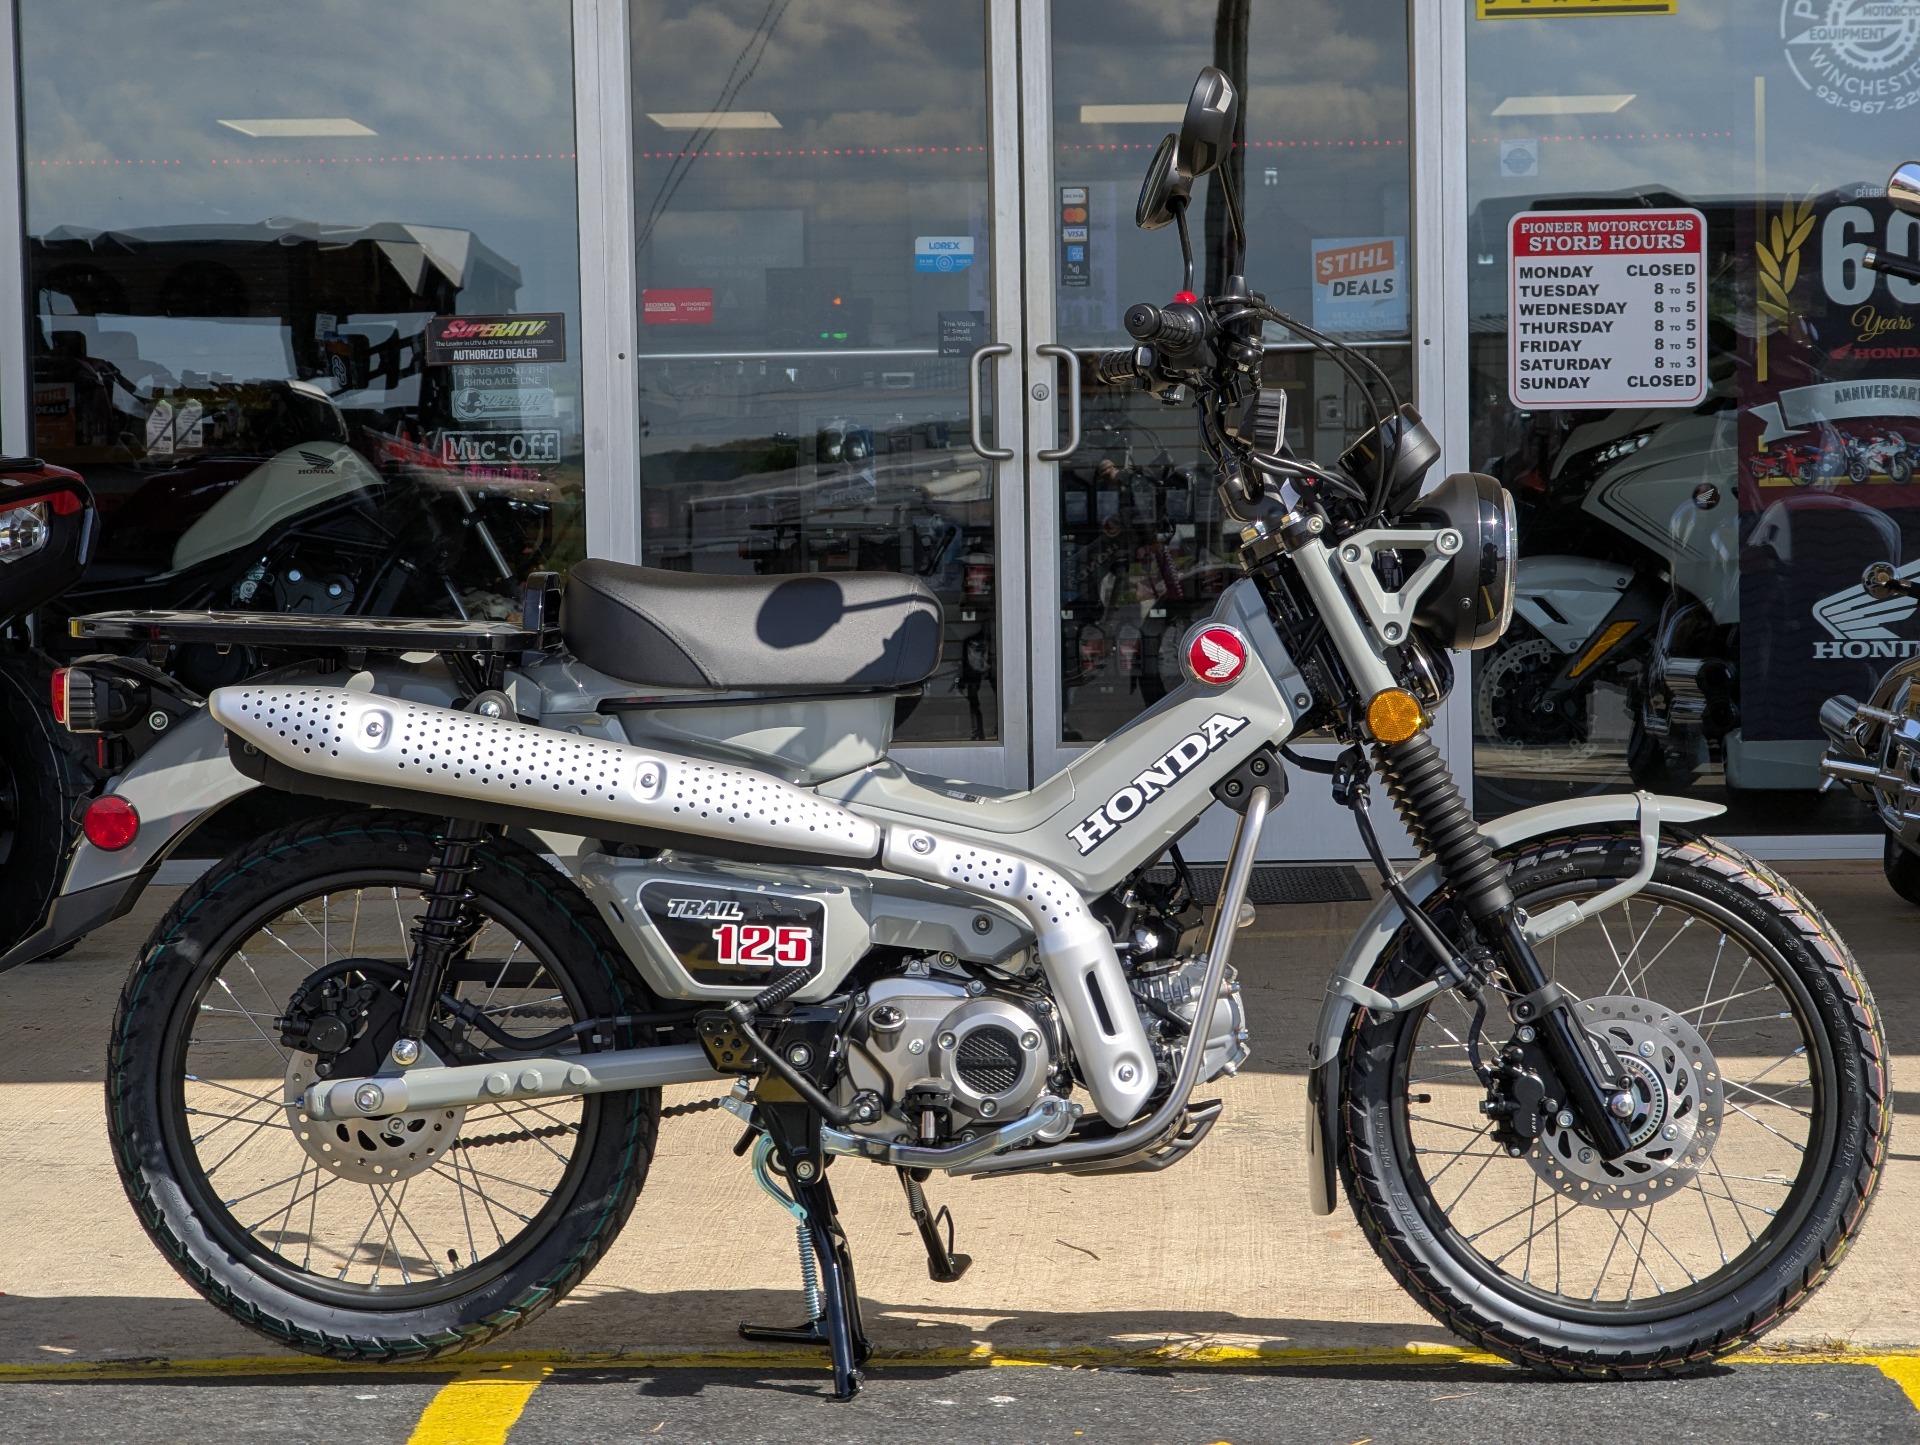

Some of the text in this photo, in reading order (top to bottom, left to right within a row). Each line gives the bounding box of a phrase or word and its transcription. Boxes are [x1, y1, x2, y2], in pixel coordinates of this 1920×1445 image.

[1810, 28, 1885, 40] EQUIPMENT
[1816, 84, 1920, 114] 931-967-22
[1856, 188, 1887, 198] CELEBR
[1521, 220, 1694, 234] PIONEER MOTORCYCLES
[928, 242, 960, 250] LOREX
[1529, 234, 1686, 251] STORE HOURS
[1320, 248, 1388, 276] STIHL
[1520, 264, 1696, 278] MONDAY CLOSED
[1332, 278, 1394, 296] DEALS
[1520, 284, 1600, 297] TUESDAY
[1654, 282, 1664, 294] 8
[1686, 282, 1696, 294] 5
[1520, 302, 1627, 316] WEDNESDAY
[1654, 301, 1664, 313] 8
[1686, 300, 1696, 313] 5
[1520, 321, 1614, 334] THURSDAY
[1654, 320, 1664, 332] 8
[1686, 319, 1696, 331] 5
[1852, 305, 1914, 342] Years
[1520, 340, 1582, 352] FRIDAY
[1654, 338, 1664, 350] 8
[1686, 338, 1696, 350] 5
[454, 348, 538, 360] AUTHORIZED DEALER
[1854, 348, 1920, 358] HOND
[1520, 358, 1612, 371] SATURDAY
[1654, 356, 1664, 368] 8
[1686, 356, 1696, 368] 3
[458, 368, 476, 376] ASK
[480, 367, 491, 375] US
[464, 378, 492, 386] RHINO
[1520, 374, 1696, 390] SUNDAY CLOSED
[1834, 384, 1920, 404] ANNIVERSAR
[448, 434, 555, 460] Muc-Off
[1066, 712, 1251, 856] HONDA
[668, 898, 744, 920] TRAIL
[712, 924, 812, 966] 125
